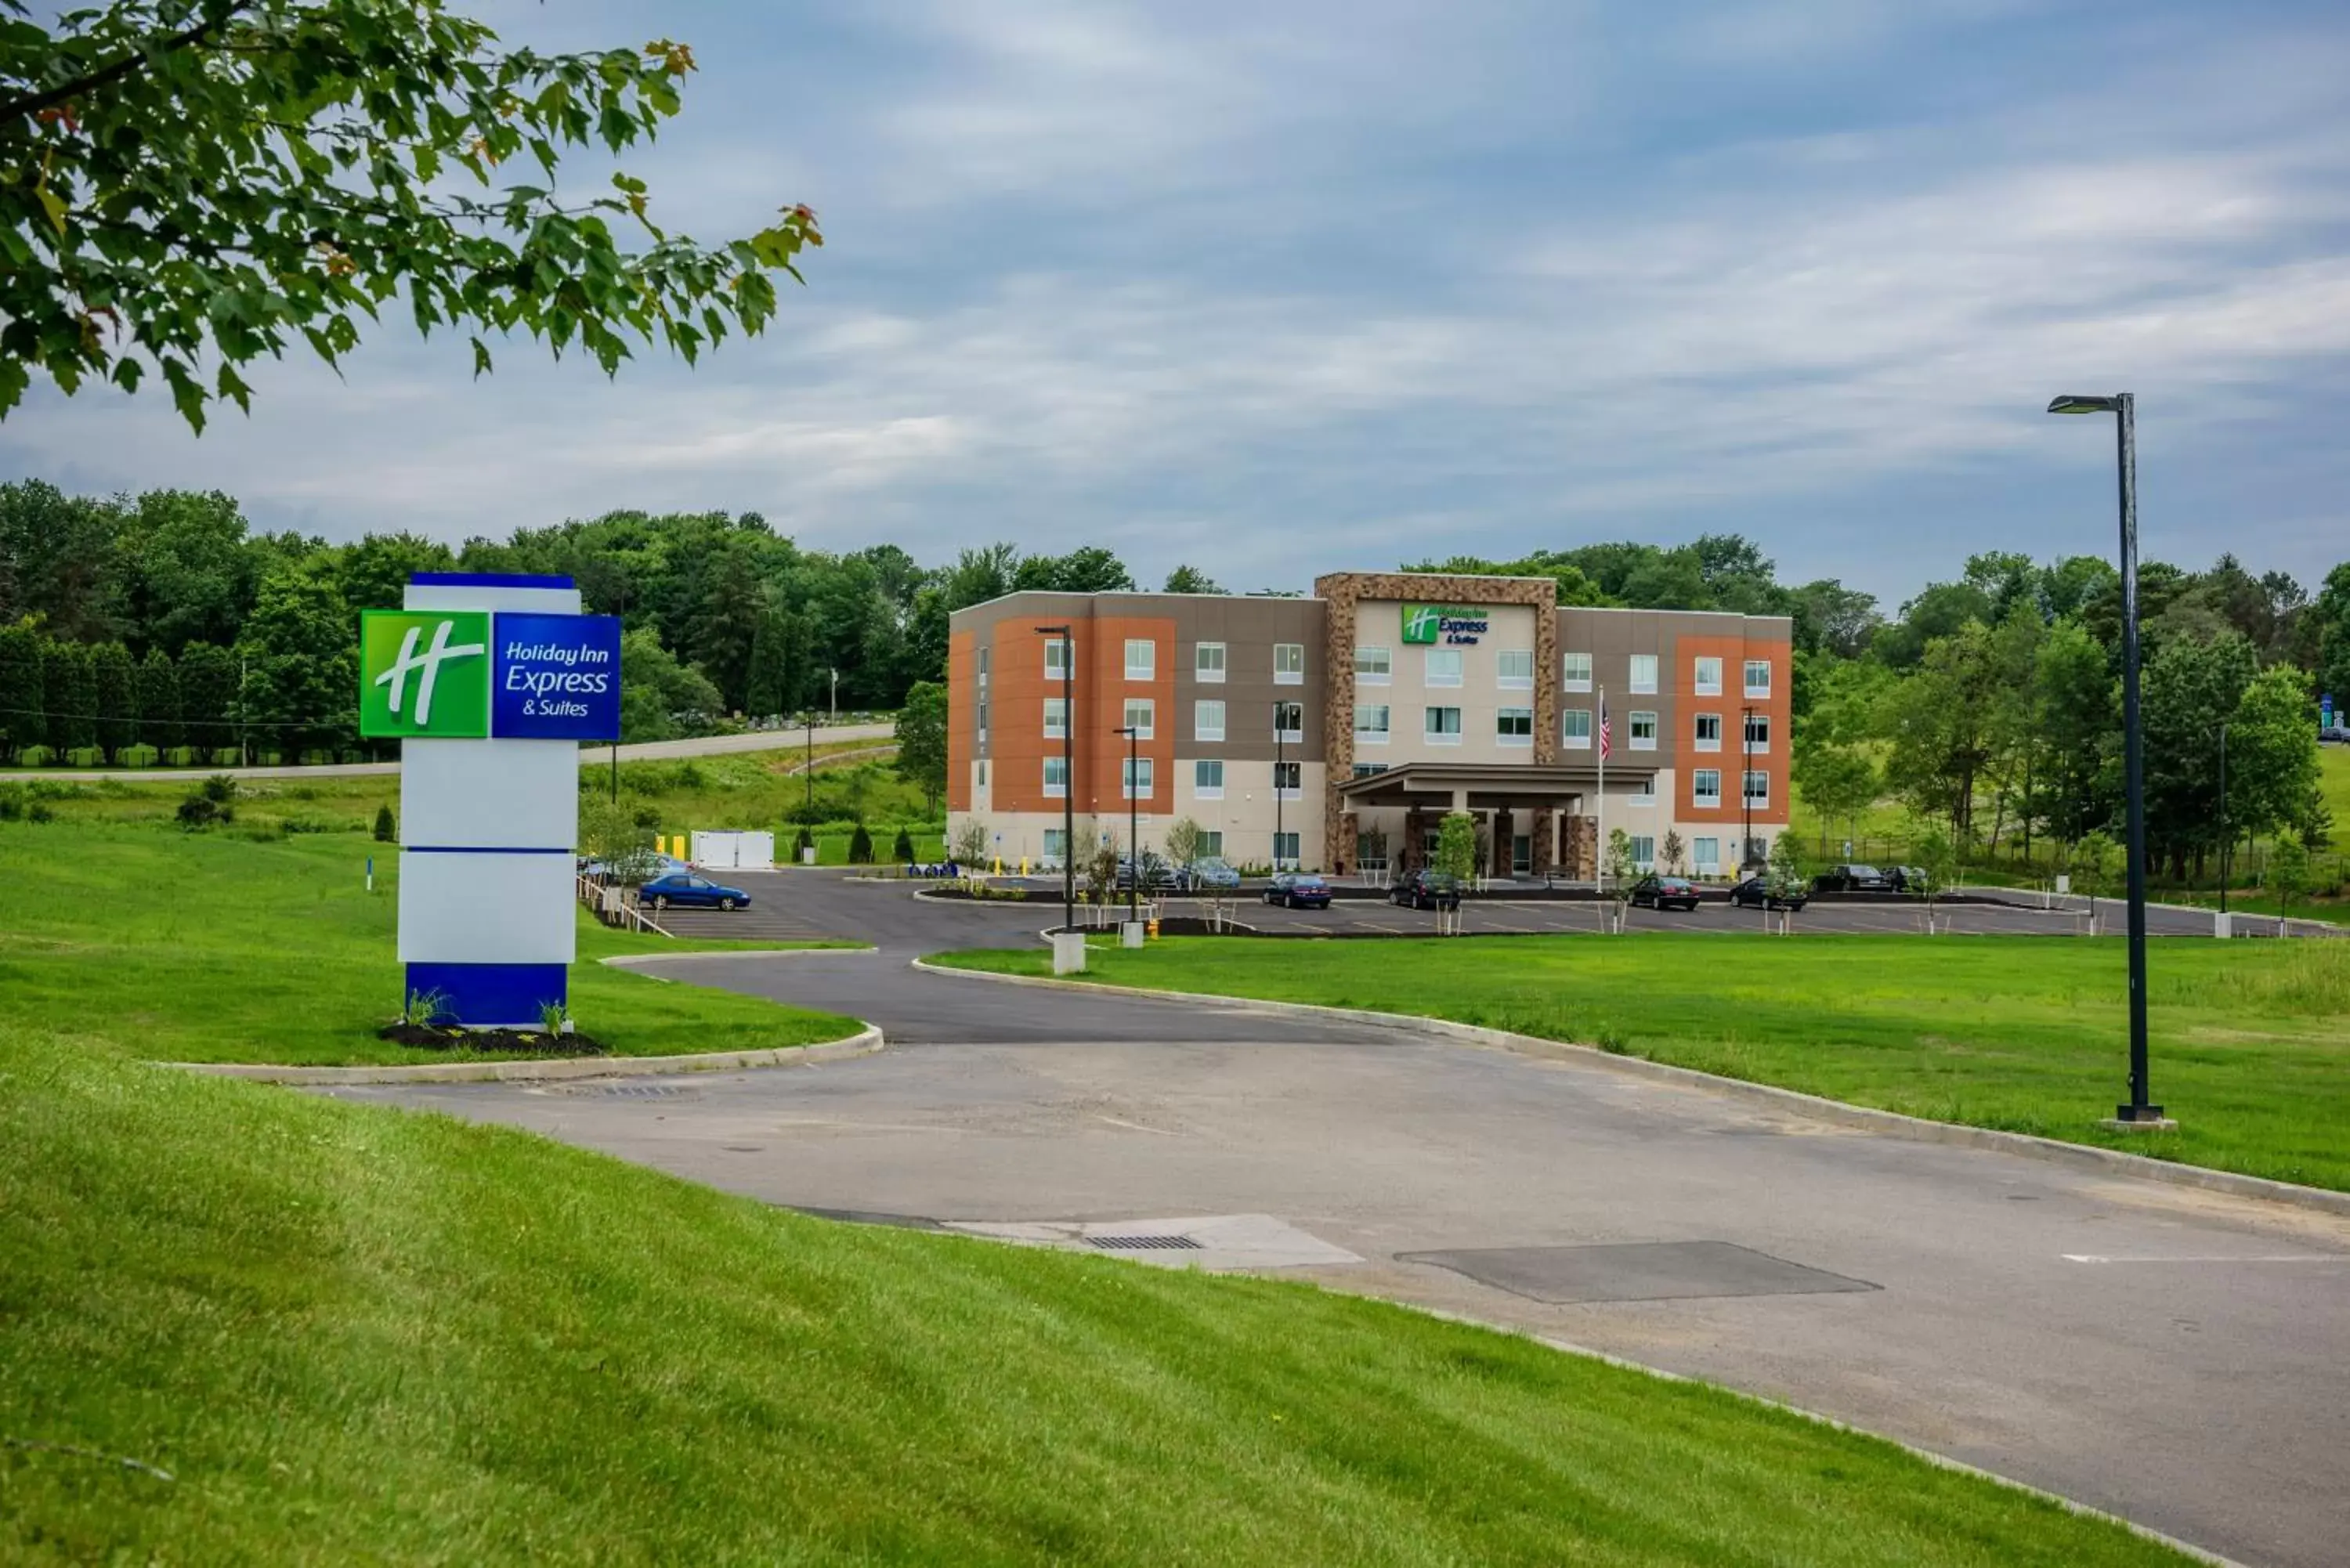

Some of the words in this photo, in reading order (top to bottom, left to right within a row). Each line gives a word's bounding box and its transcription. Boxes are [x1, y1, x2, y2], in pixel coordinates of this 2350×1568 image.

[1439, 617, 1488, 634] Express
[506, 641, 577, 666] Holiday
[580, 643, 609, 663] Inn
[506, 666, 608, 697] Express
[522, 699, 535, 715] &
[539, 699, 588, 717] Suites
